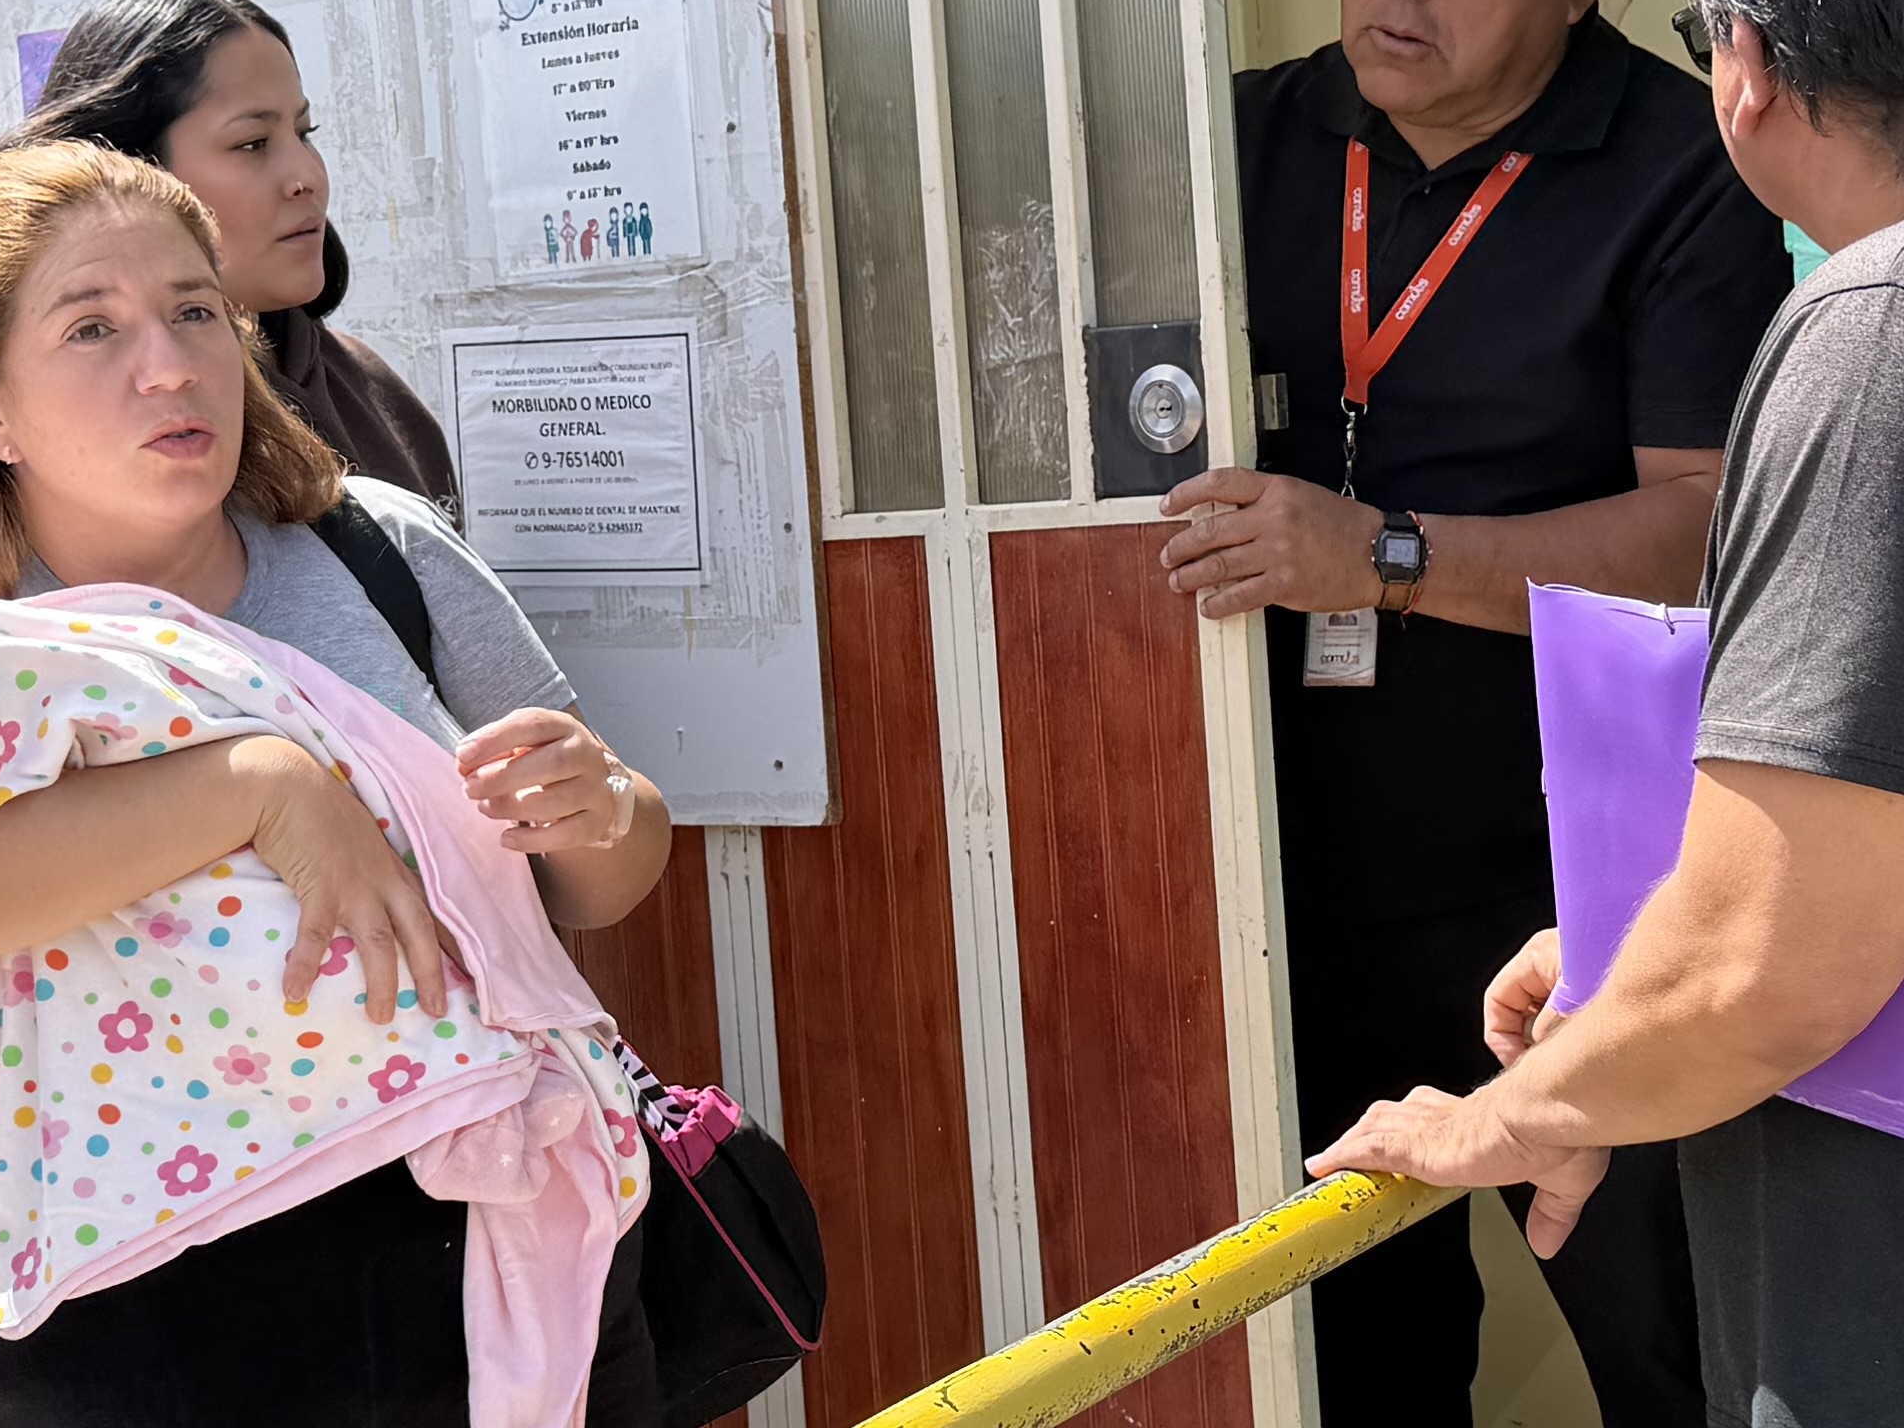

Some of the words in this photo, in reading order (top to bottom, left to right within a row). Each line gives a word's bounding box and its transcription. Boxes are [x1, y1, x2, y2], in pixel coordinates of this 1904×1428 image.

[521, 25, 585, 47] Extensión
[587, 16, 640, 38] Horaria
[565, 109, 607, 123] Viernes
[573, 159, 611, 174] Sábado
[492, 397, 577, 414] MORBILIDAD
[580, 396, 592, 411] O
[595, 394, 652, 411] MEDICO
[539, 421, 606, 438] GENERAL.
[542, 450, 625, 469] 9-76514001
[520, 508, 536, 517] QUE
[538, 508, 547, 516] EL
[585, 507, 595, 516] DE
[597, 506, 626, 515] DENTAL
[639, 504, 681, 515] MANTIENE
[515, 524, 532, 533] CON
[533, 523, 587, 533] NORMALIDAD
